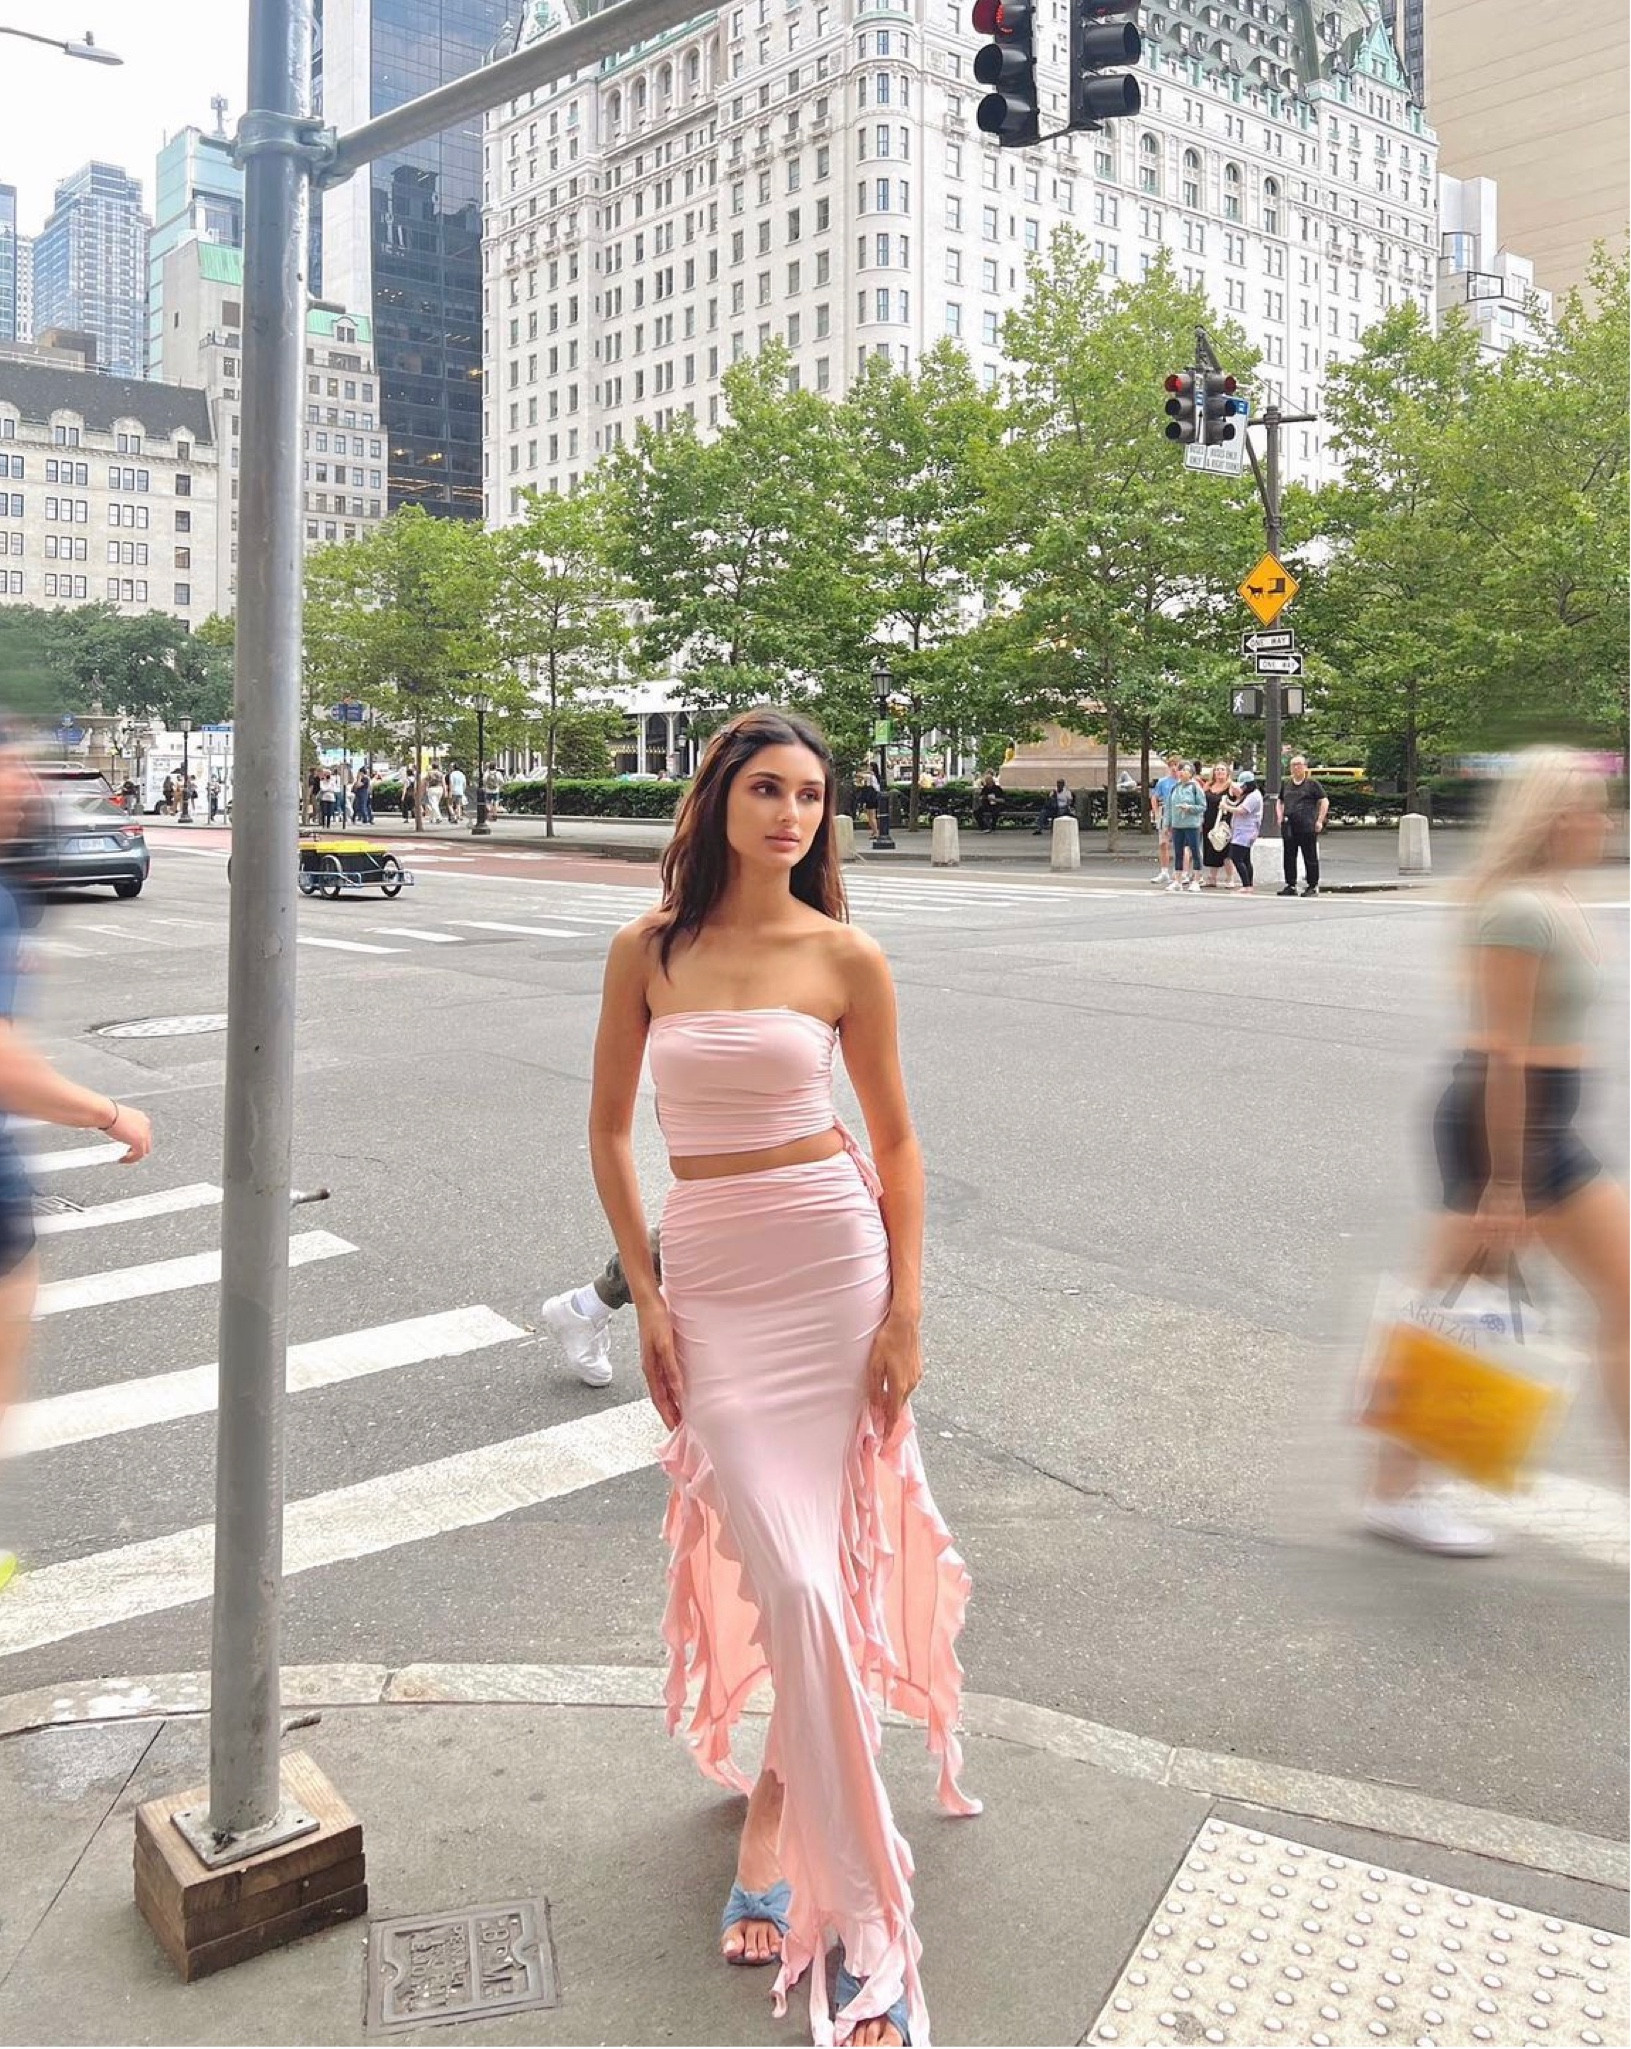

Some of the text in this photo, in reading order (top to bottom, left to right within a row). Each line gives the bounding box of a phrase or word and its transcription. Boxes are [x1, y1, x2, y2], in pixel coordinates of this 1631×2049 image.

[1250, 636, 1286, 648] ONE WAY
[1262, 660, 1296, 669] ONE WAY
[1402, 1299, 1477, 1351] ARITZIA
